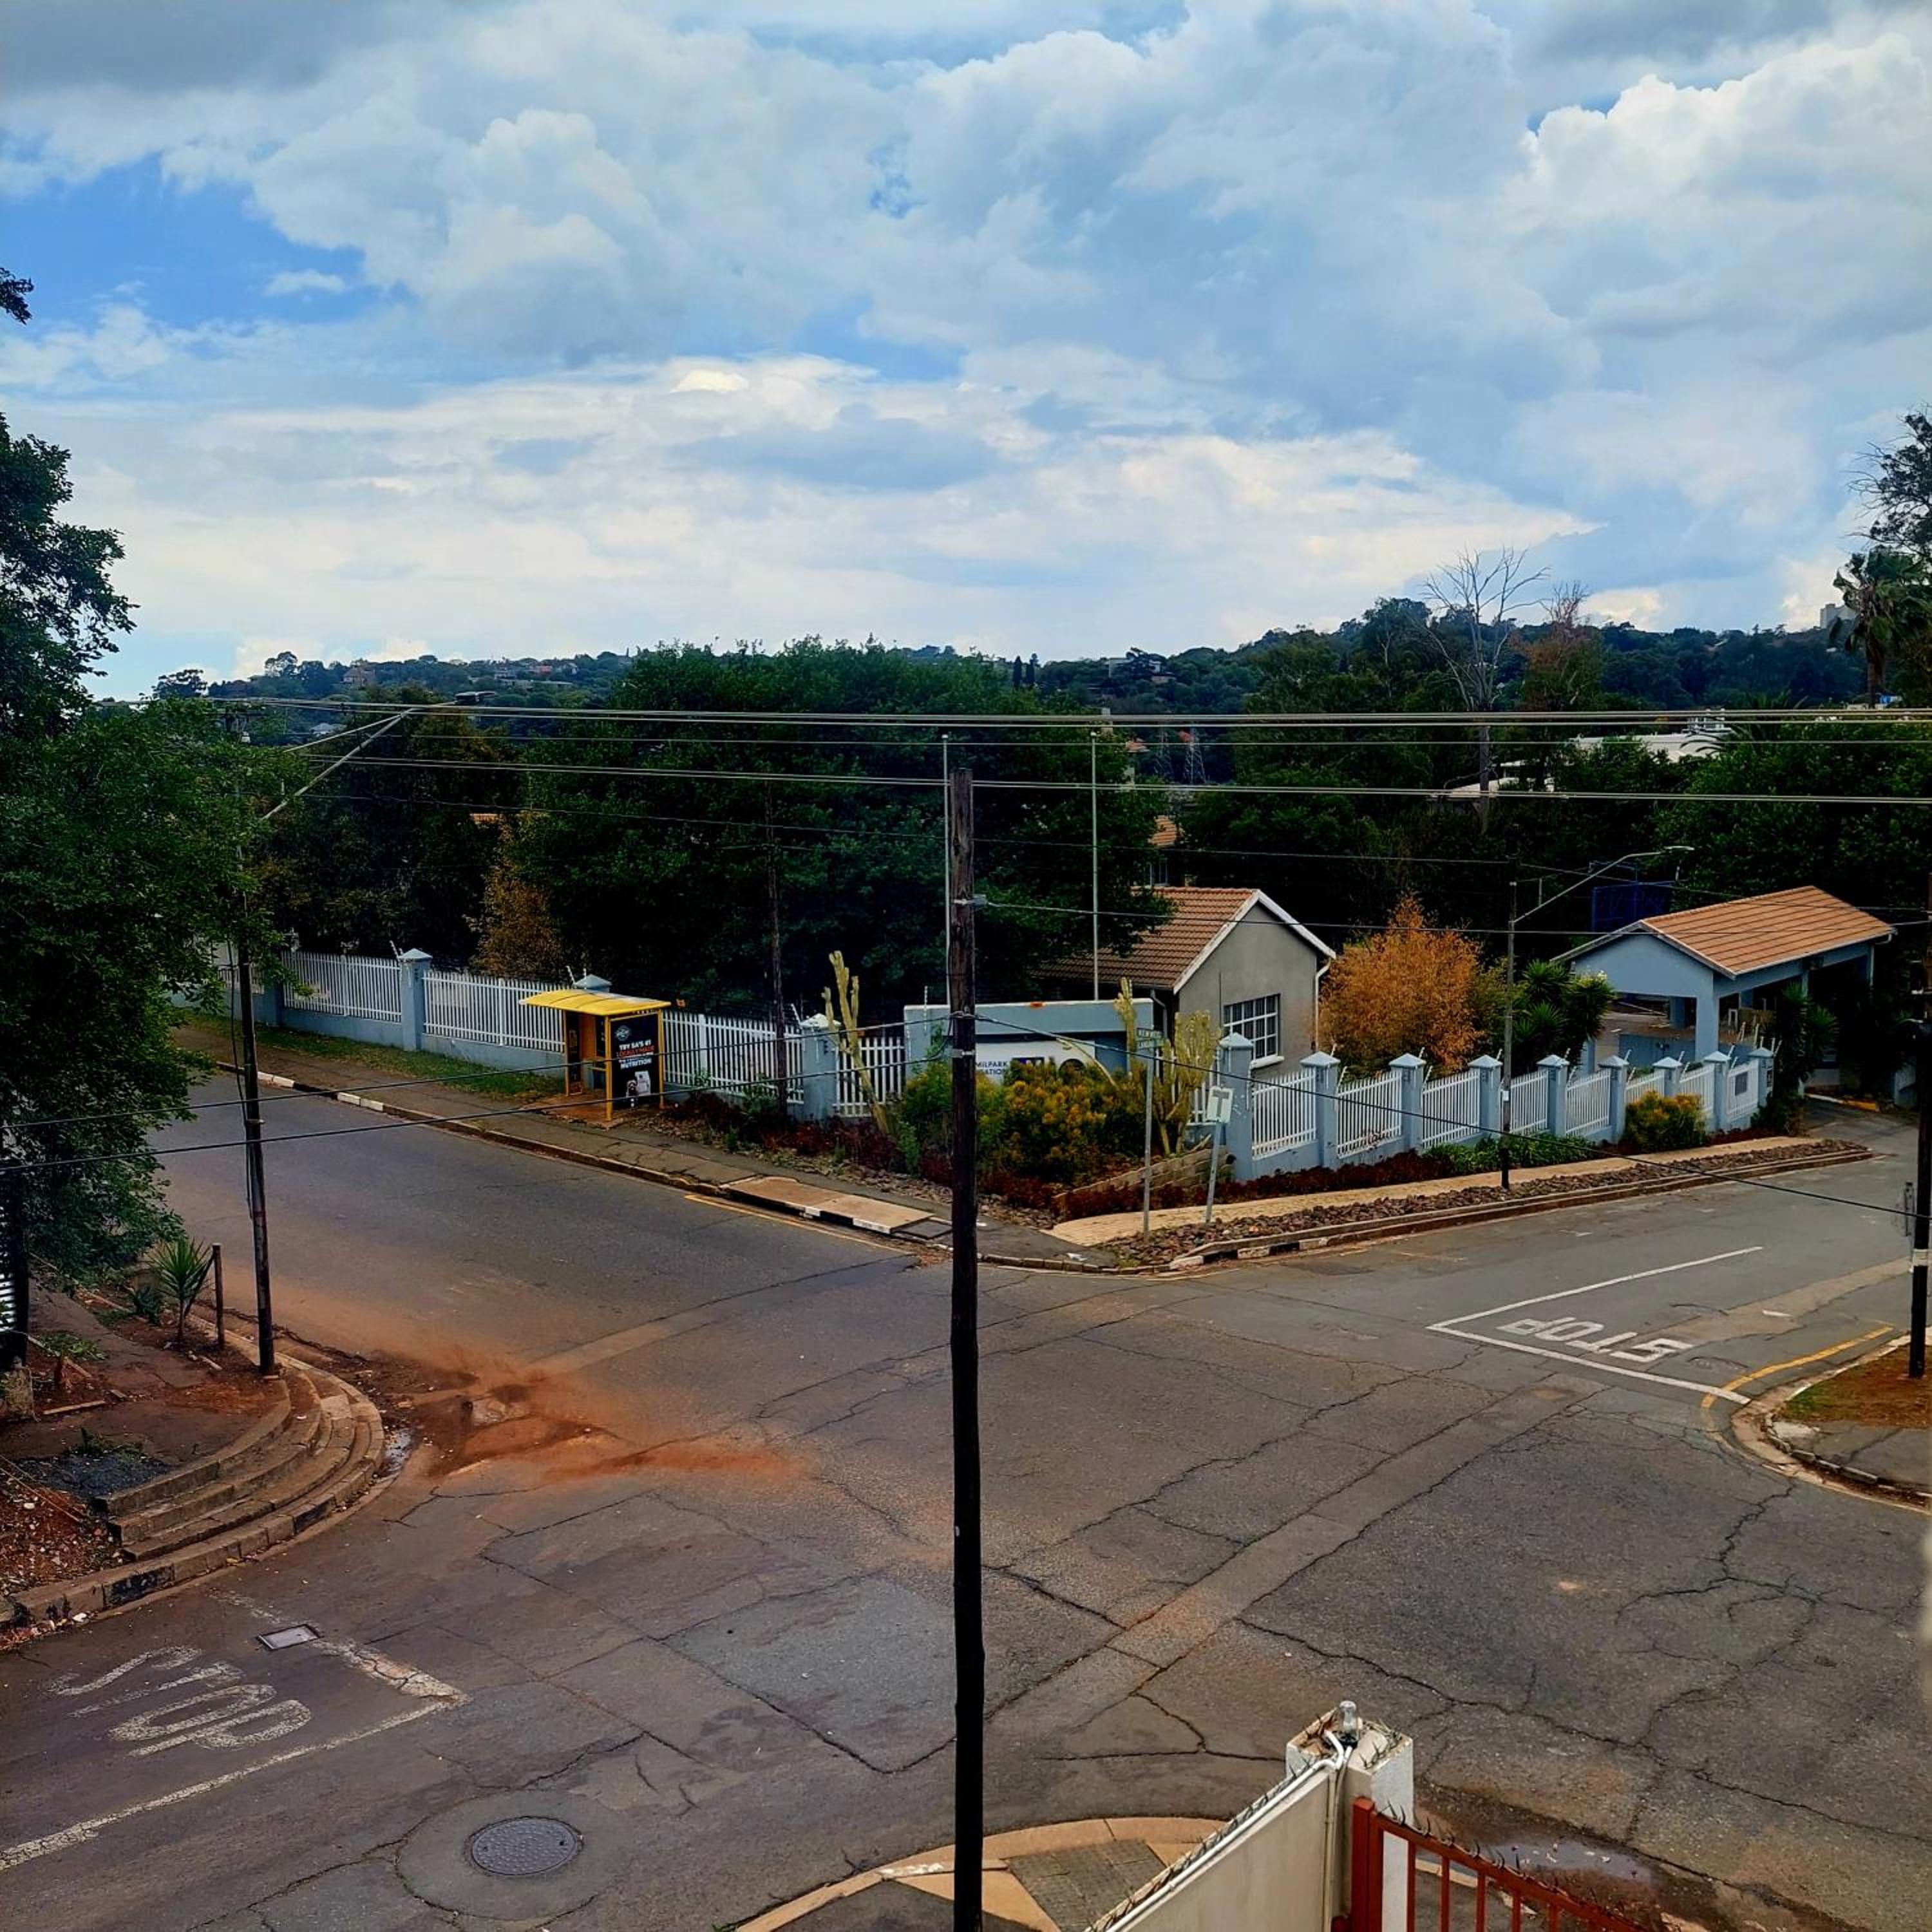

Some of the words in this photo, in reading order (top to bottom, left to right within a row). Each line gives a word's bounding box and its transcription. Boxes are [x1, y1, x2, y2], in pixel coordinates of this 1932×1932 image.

[620, 1058, 652, 1068] NUTRITION
[1495, 1316, 1695, 1363] STOP
[44, 1645, 312, 1757] STOP
